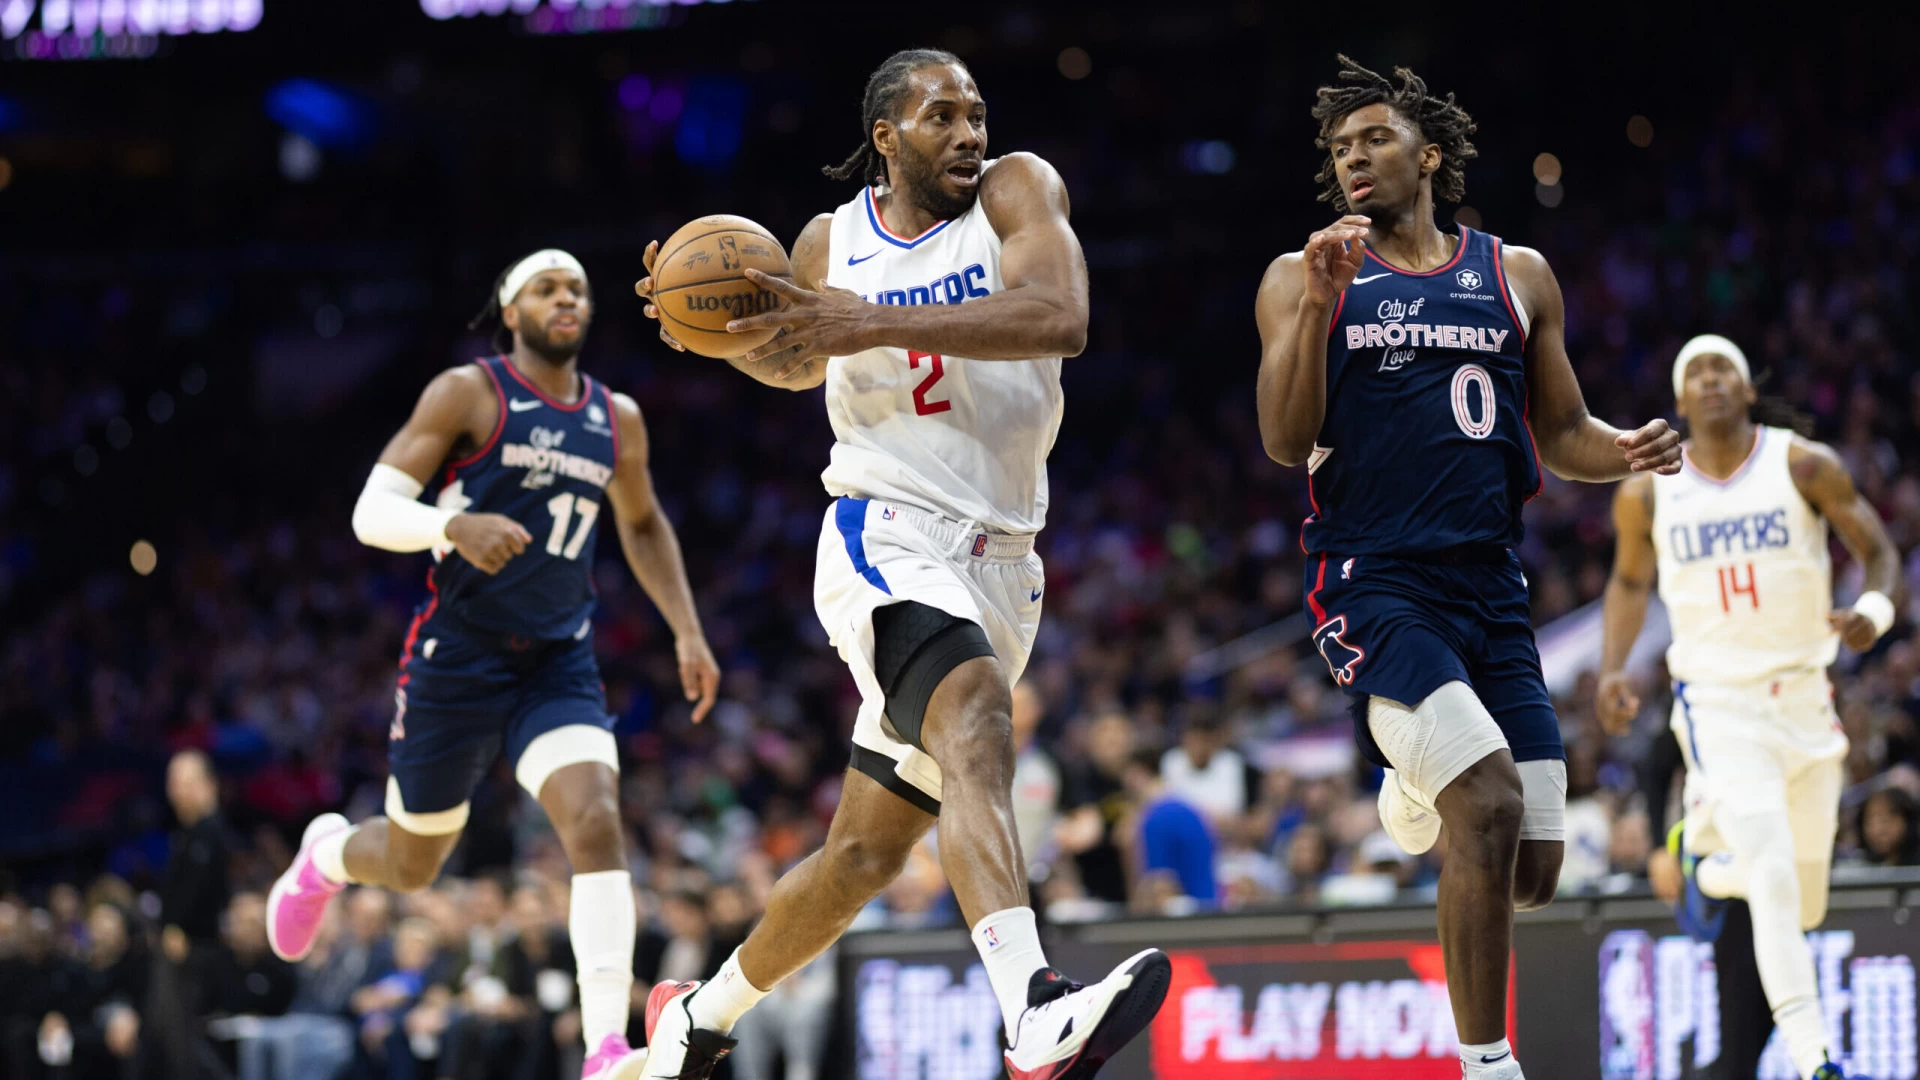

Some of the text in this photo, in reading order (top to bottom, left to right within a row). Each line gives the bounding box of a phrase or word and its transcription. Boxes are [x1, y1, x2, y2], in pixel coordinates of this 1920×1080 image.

[1377, 297, 1425, 326] City of
[1450, 292, 1495, 301] crypto.com
[1346, 323, 1509, 352] BROTHERLY
[1378, 345, 1416, 372] Love
[907, 350, 951, 416] 2
[1451, 364, 1496, 439] 0
[546, 492, 600, 560] 17
[1670, 507, 1789, 565] CLIPPERS
[1717, 560, 1760, 614] 14
[1180, 983, 1332, 1061] PLAY
